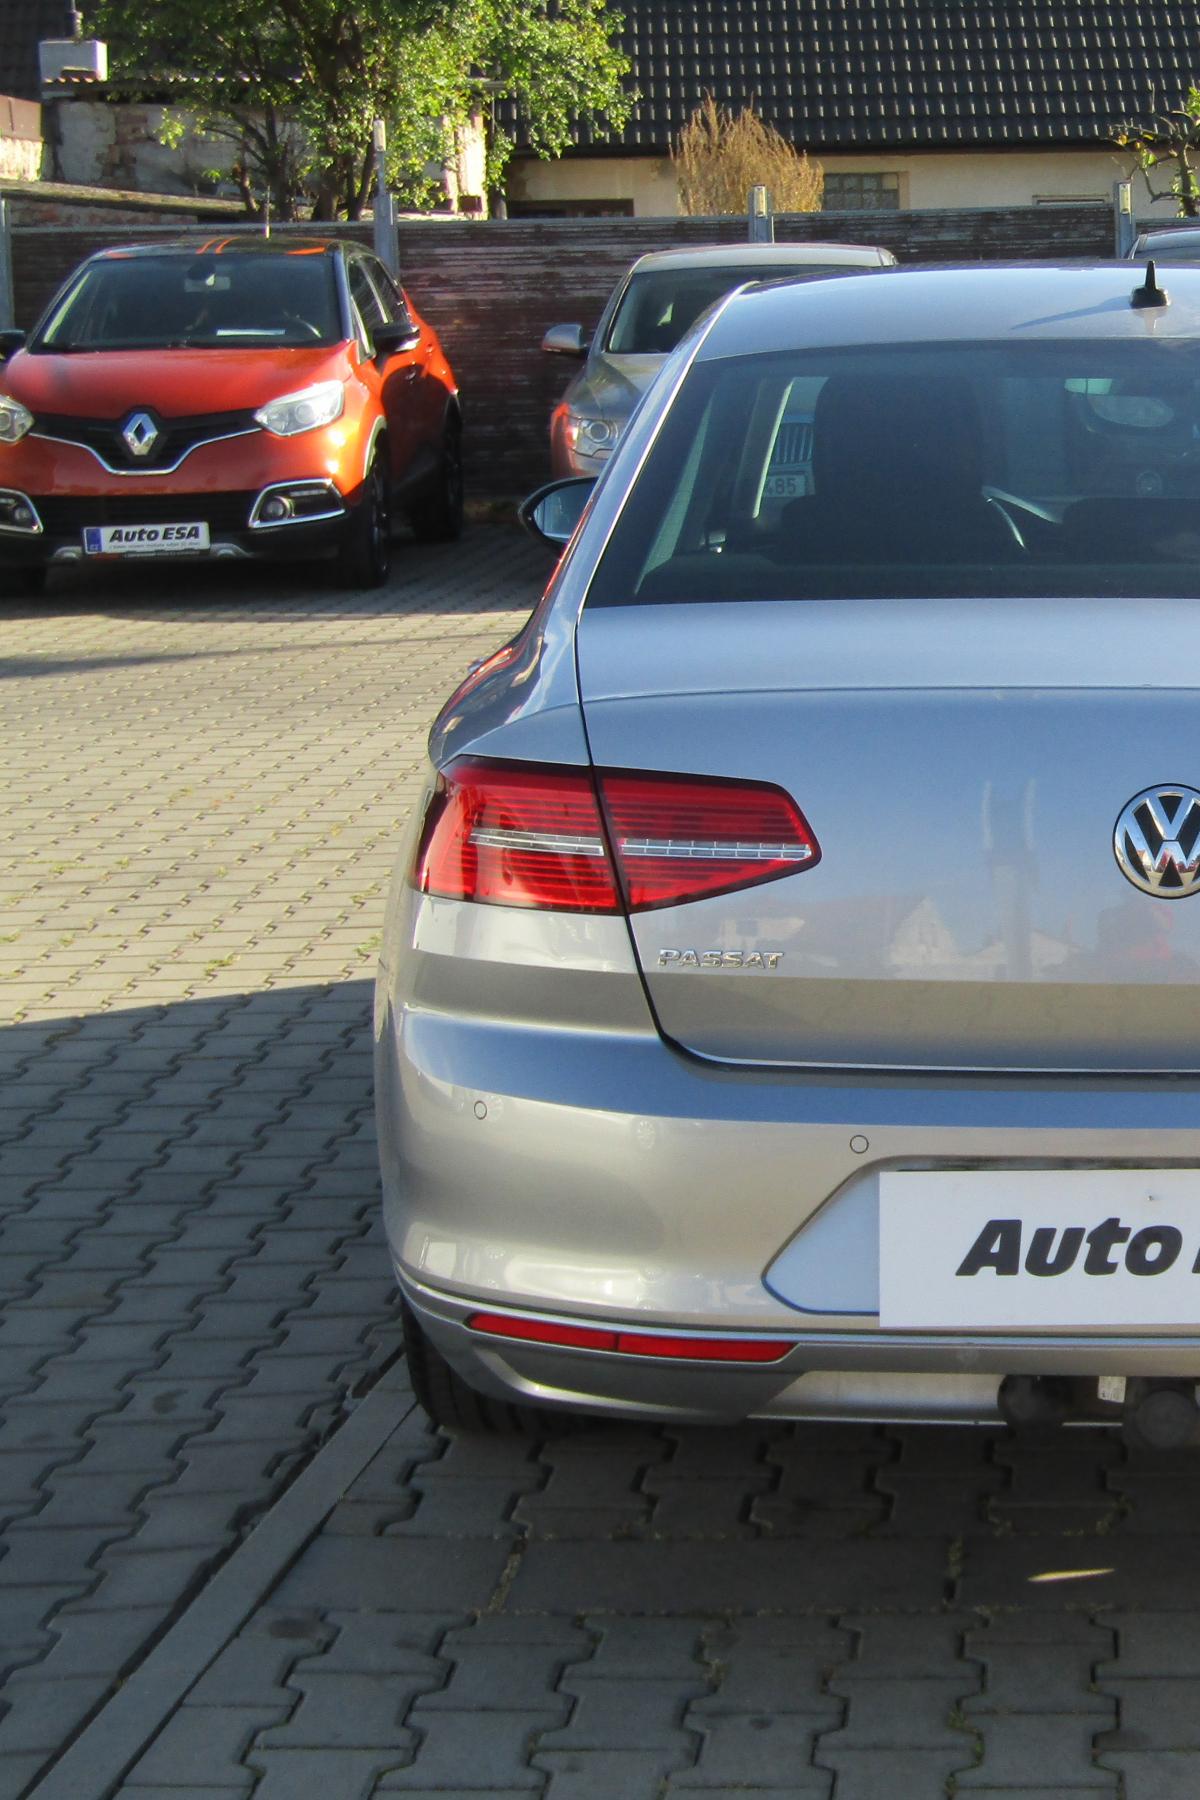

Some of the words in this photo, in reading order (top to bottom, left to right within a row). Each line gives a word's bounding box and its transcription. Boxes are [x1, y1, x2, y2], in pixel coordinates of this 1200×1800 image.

[109, 528, 159, 542] Auto
[162, 526, 200, 540] ESA
[657, 949, 784, 969] PASSAT
[955, 1217, 1183, 1277] Auto
